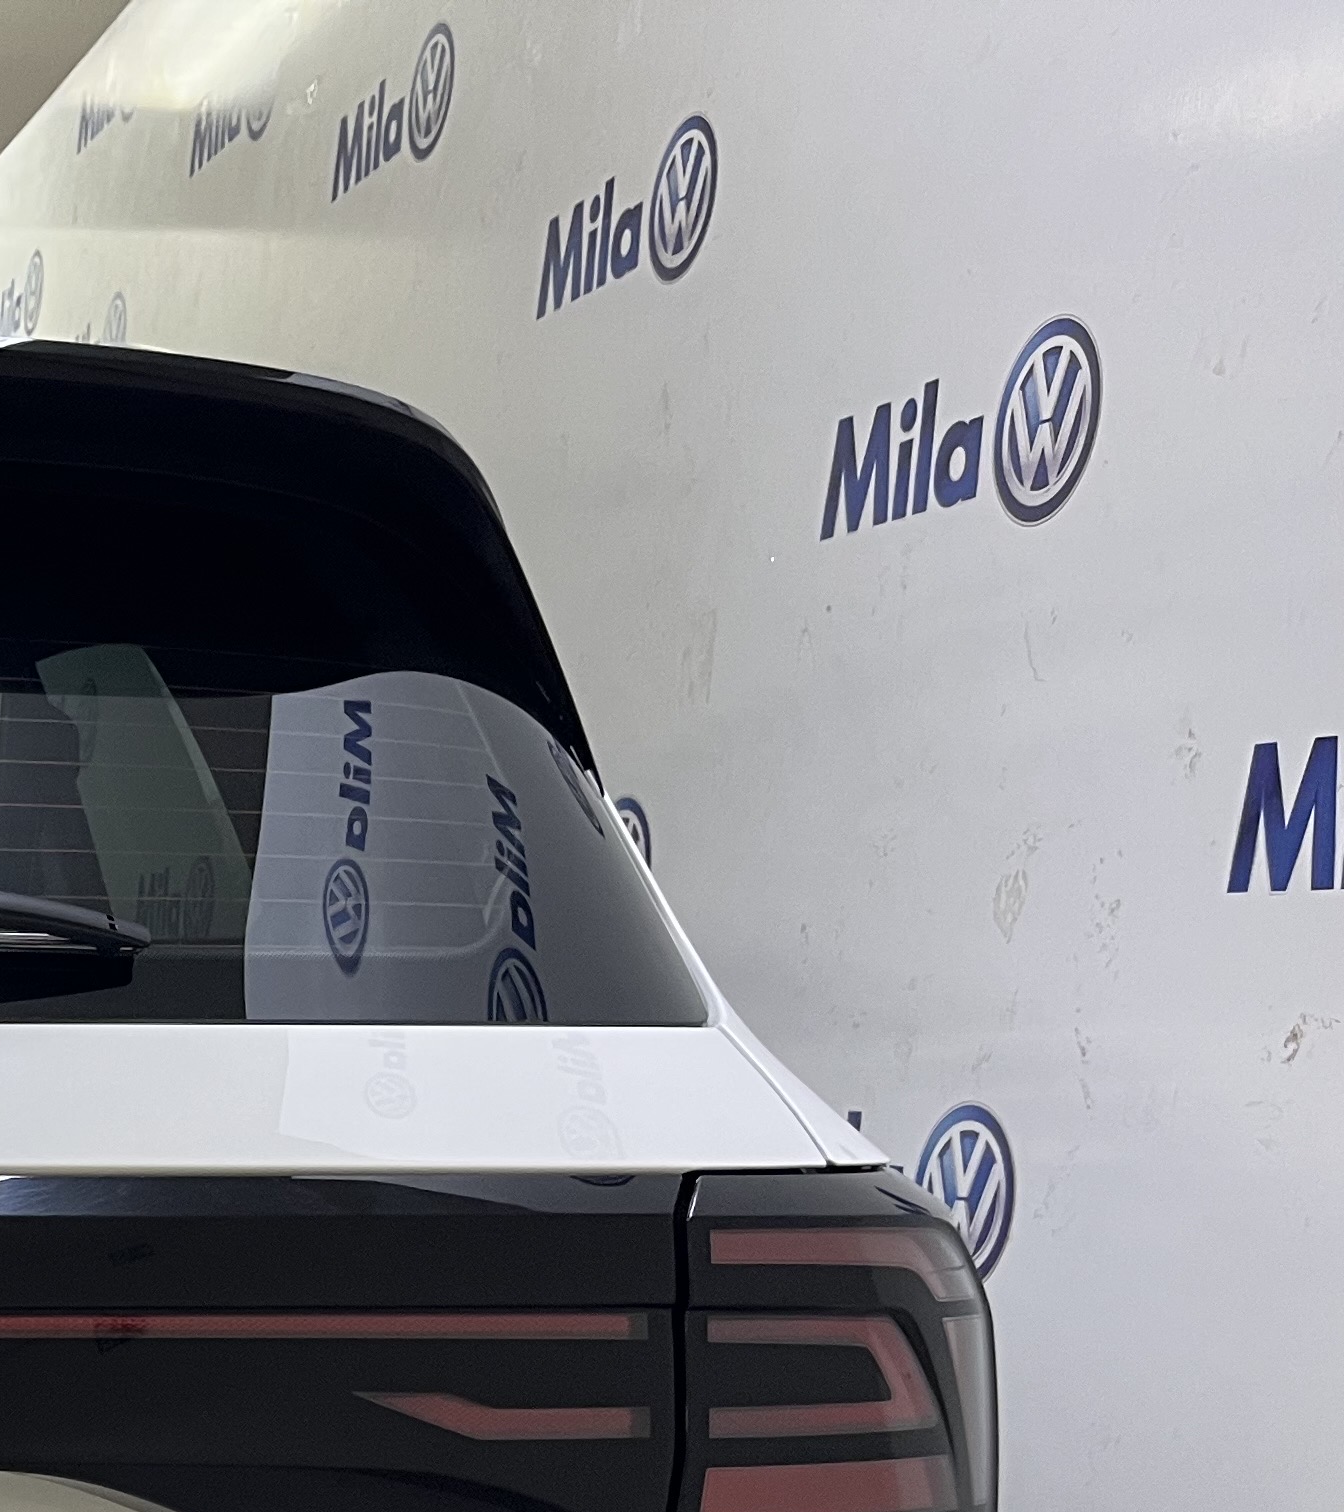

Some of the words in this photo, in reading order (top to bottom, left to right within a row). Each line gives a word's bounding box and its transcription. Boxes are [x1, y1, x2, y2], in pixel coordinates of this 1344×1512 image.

[331, 78, 404, 202] Mila
[535, 177, 643, 320] Mila
[819, 378, 985, 541] Mila
